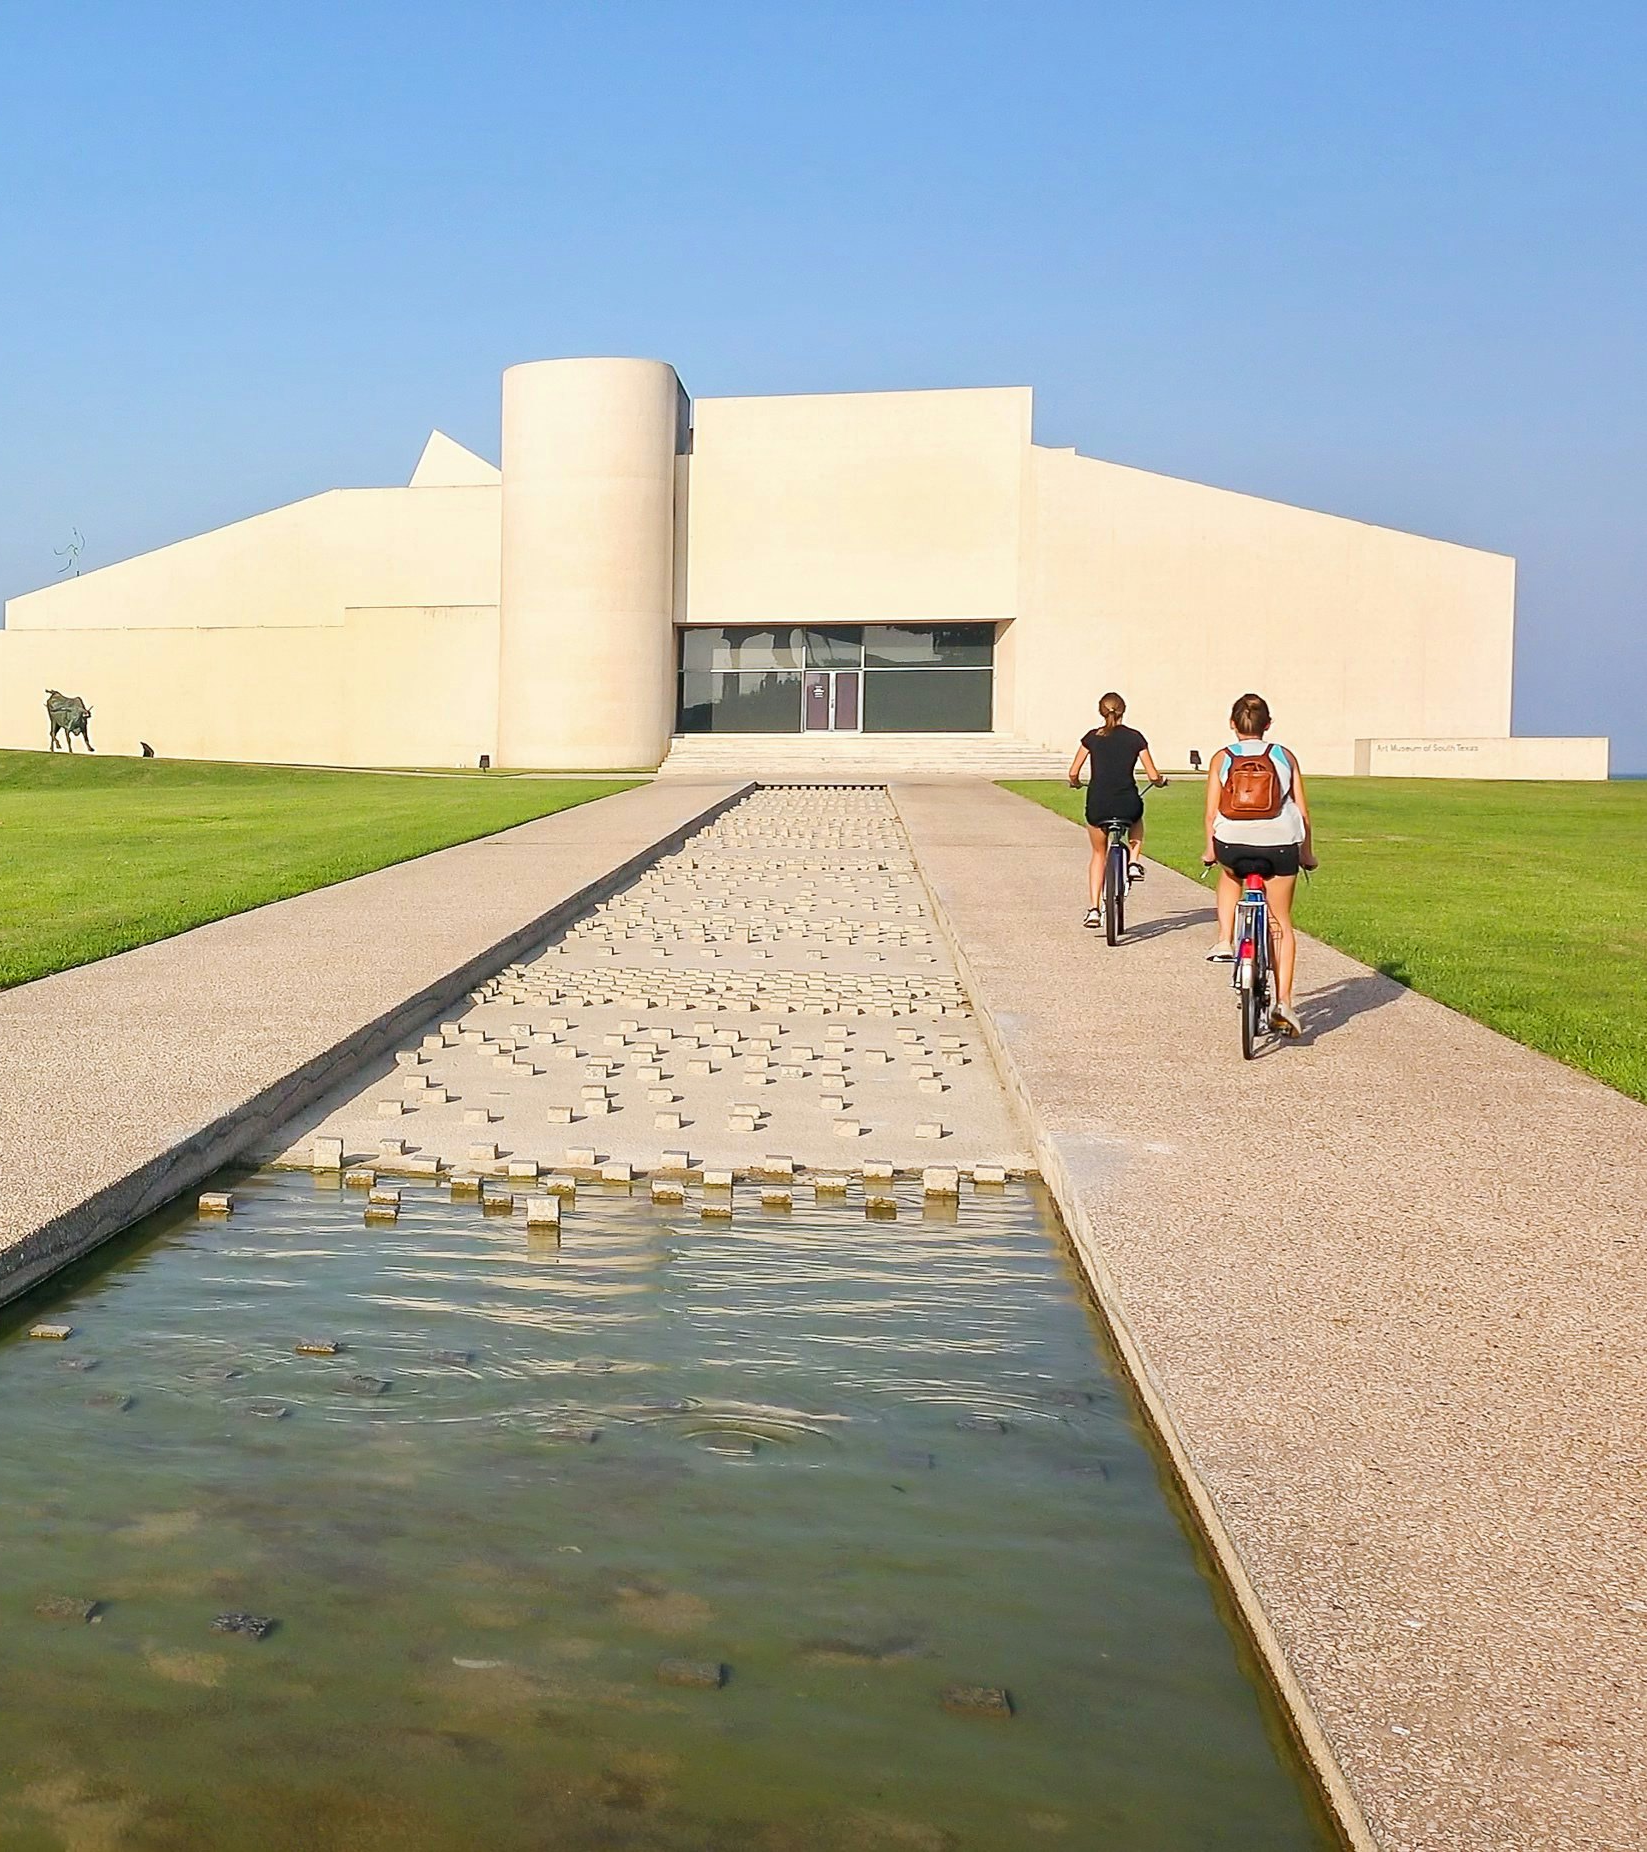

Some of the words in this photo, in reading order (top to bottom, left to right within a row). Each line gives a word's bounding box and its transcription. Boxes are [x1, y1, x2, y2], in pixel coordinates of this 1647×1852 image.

[1377, 744, 1389, 752] Art
[1390, 744, 1422, 752] Museum
[1423, 744, 1431, 752] of
[1433, 744, 1455, 752] South
[1457, 743, 1479, 752] Texas
